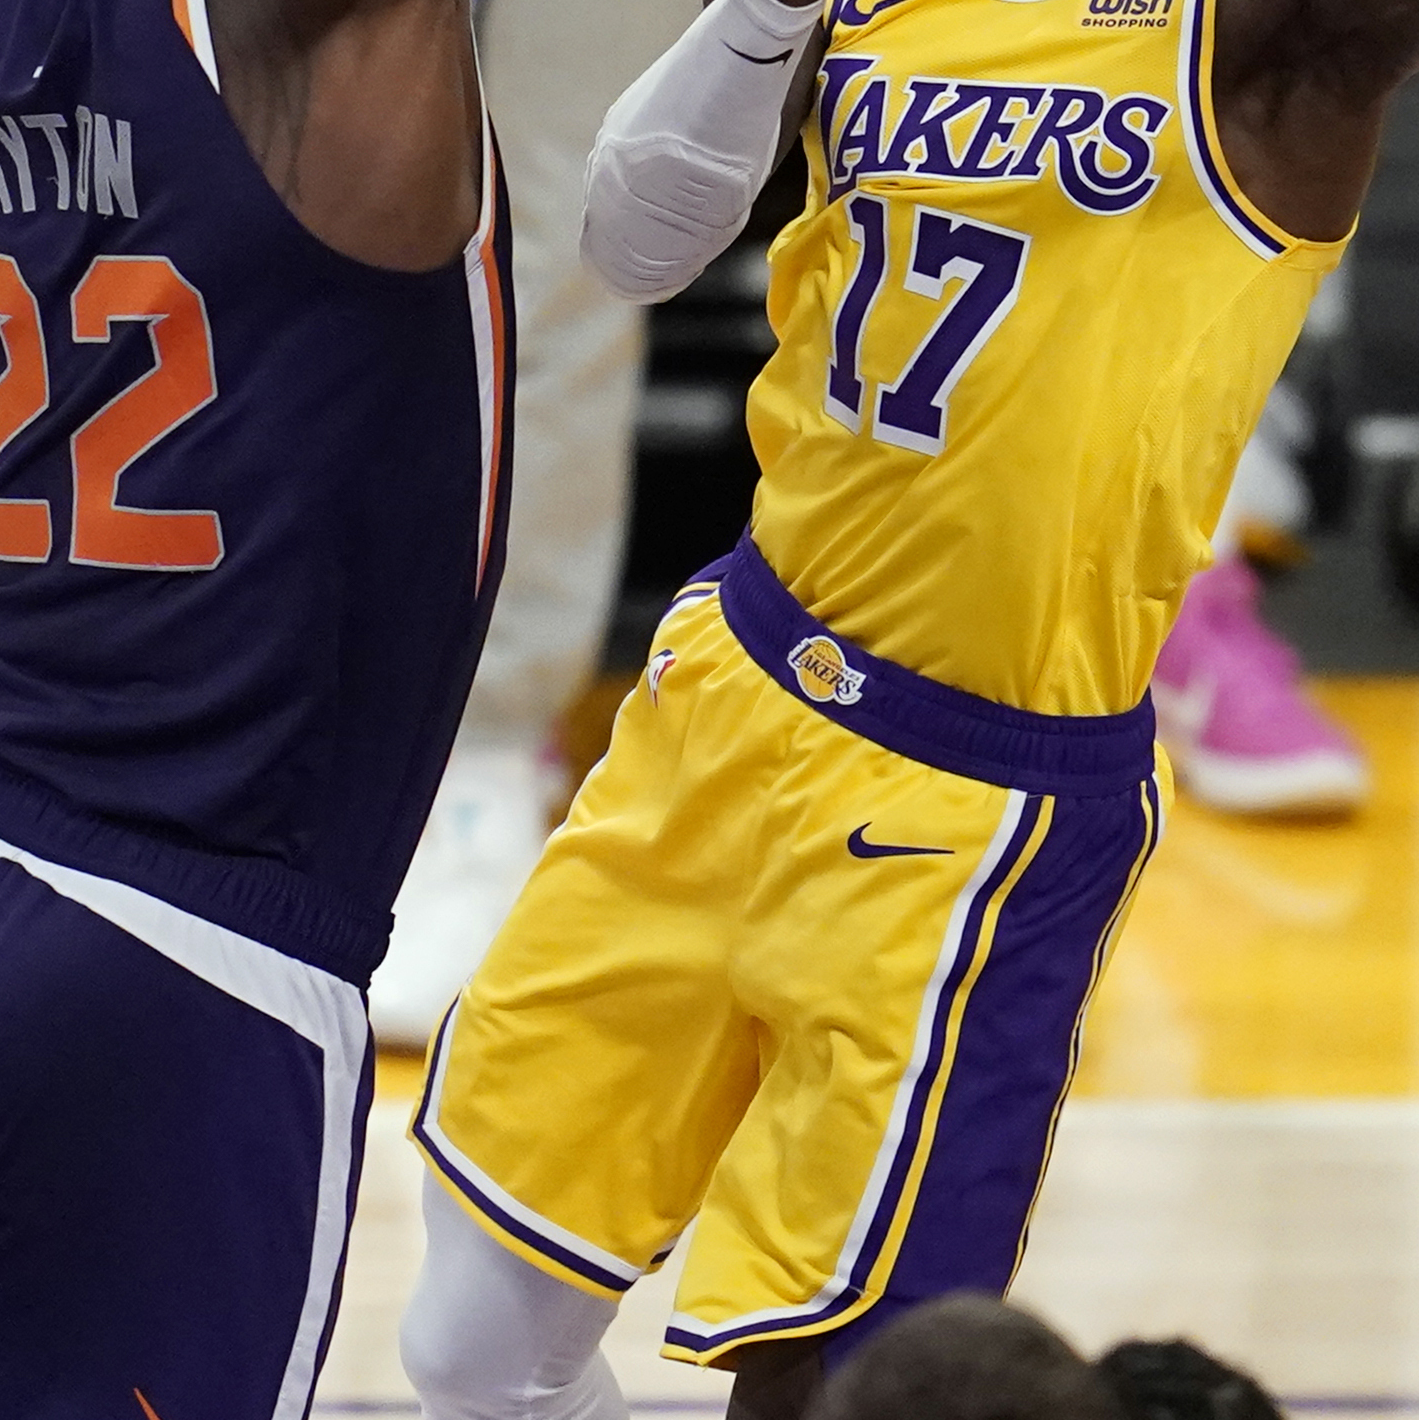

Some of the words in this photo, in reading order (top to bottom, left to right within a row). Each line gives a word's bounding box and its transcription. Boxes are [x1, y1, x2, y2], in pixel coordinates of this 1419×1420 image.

[1081, 18, 1168, 27] SHOPPING
[817, 53, 1175, 217] LAKERS
[824, 189, 1033, 458] 17
[791, 642, 857, 702] LAKERS
